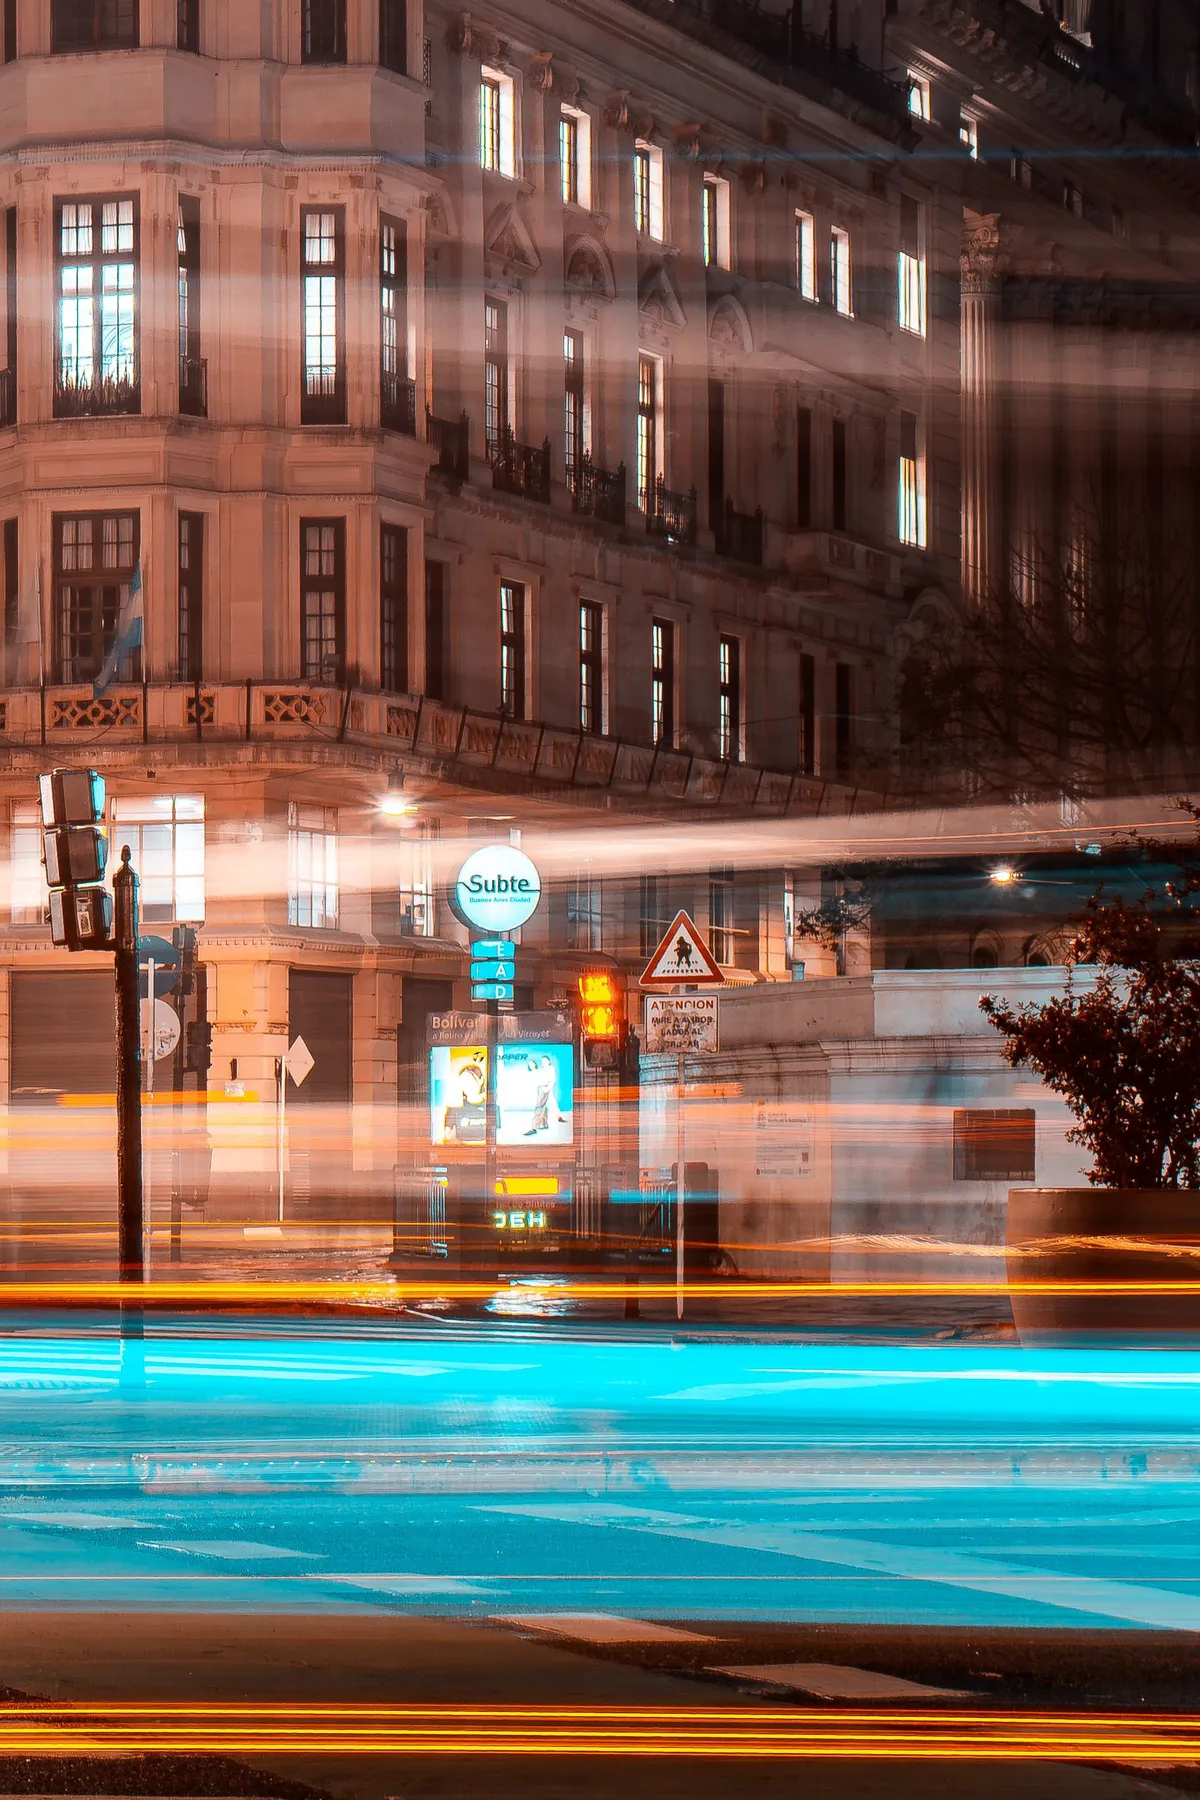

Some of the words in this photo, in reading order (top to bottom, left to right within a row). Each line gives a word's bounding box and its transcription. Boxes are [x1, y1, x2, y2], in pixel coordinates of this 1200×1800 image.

[468, 874, 531, 893] Subte
[497, 943, 505, 957] E
[495, 963, 507, 978] A
[495, 985, 506, 999] D
